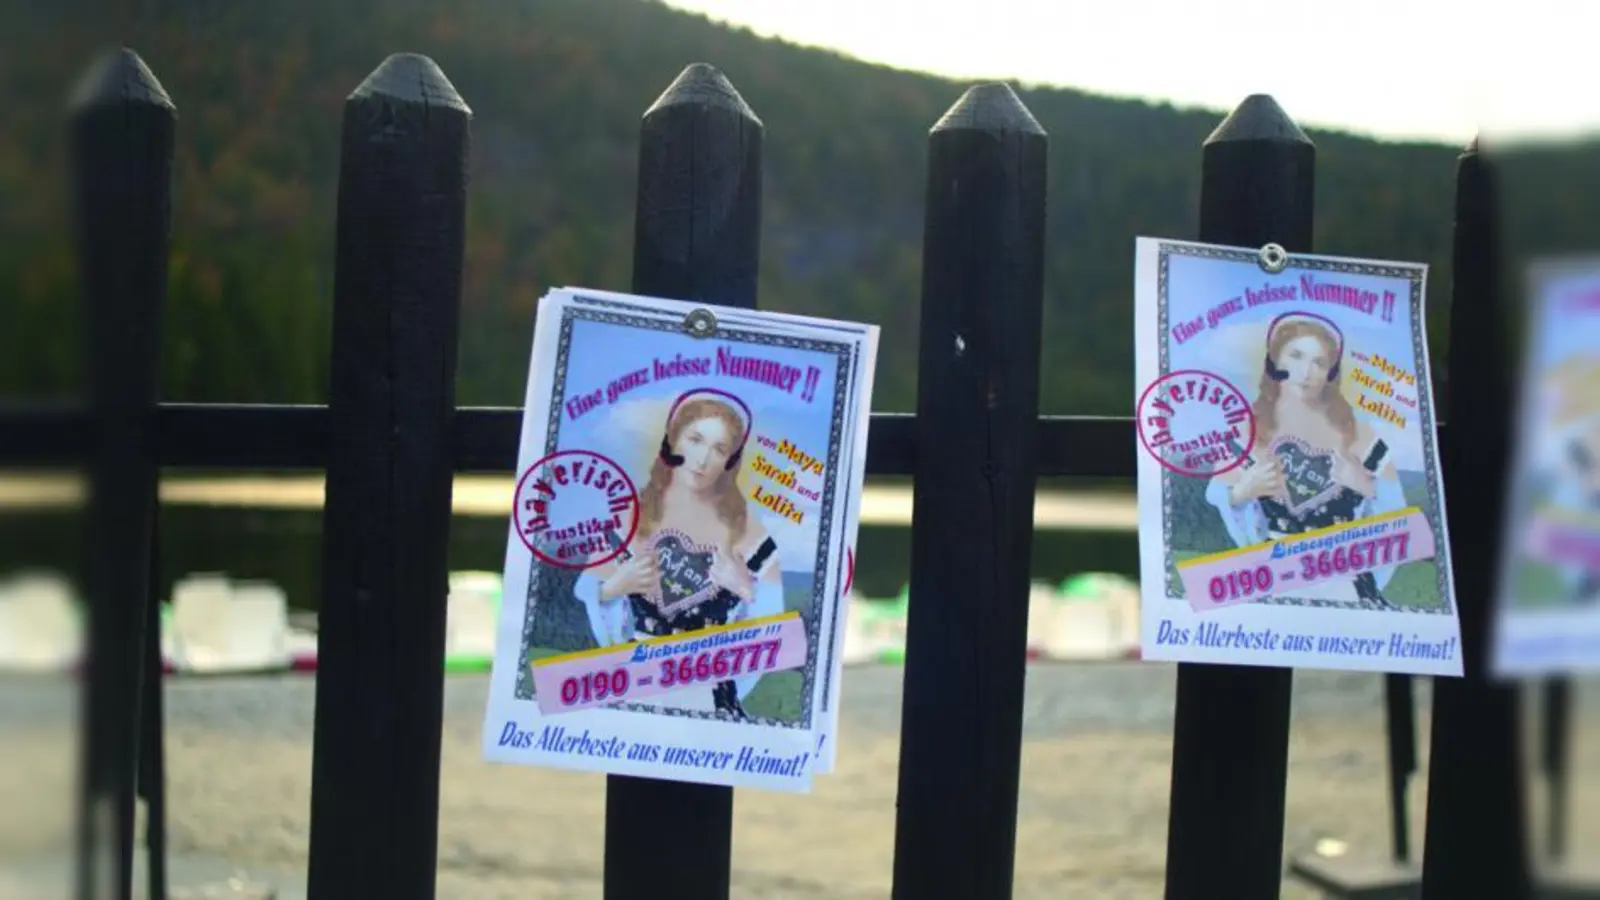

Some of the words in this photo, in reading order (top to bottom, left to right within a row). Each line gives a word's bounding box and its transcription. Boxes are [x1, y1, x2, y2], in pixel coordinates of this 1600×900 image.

[1171, 314, 1205, 344] Eine
[1206, 296, 1244, 328] ganz
[1245, 282, 1297, 308] heisse
[1299, 272, 1379, 315] Nummer
[565, 388, 603, 420] Eine
[606, 367, 649, 404] ganz
[653, 353, 711, 382] heisse
[715, 345, 801, 394] Nummer
[1351, 368, 1394, 397] Sarah
[1369, 352, 1415, 385] Maya
[1147, 377, 1249, 448] bayerisch
[1355, 393, 1406, 429] Lolita
[776, 438, 824, 476] Maya
[1171, 425, 1240, 453] rustikal
[751, 455, 796, 489] Sarah
[524, 458, 634, 536] bayerisch
[750, 486, 804, 525] Lolita
[545, 514, 622, 541] rustikal
[1208, 565, 1274, 603] 0190
[1301, 531, 1411, 581] 3666777
[1156, 619, 1191, 645] Das
[1193, 620, 1280, 651] Allerbeste
[1281, 633, 1315, 653] aus
[1317, 634, 1385, 656] unserer
[1387, 631, 1457, 661] Heimat!
[560, 667, 629, 706] 0190
[658, 638, 783, 689] 3666777
[498, 721, 534, 749] Das
[535, 724, 627, 759] Allerbeste
[627, 742, 661, 762] aus
[662, 744, 734, 770] unserer
[735, 745, 810, 778] Heimat!
